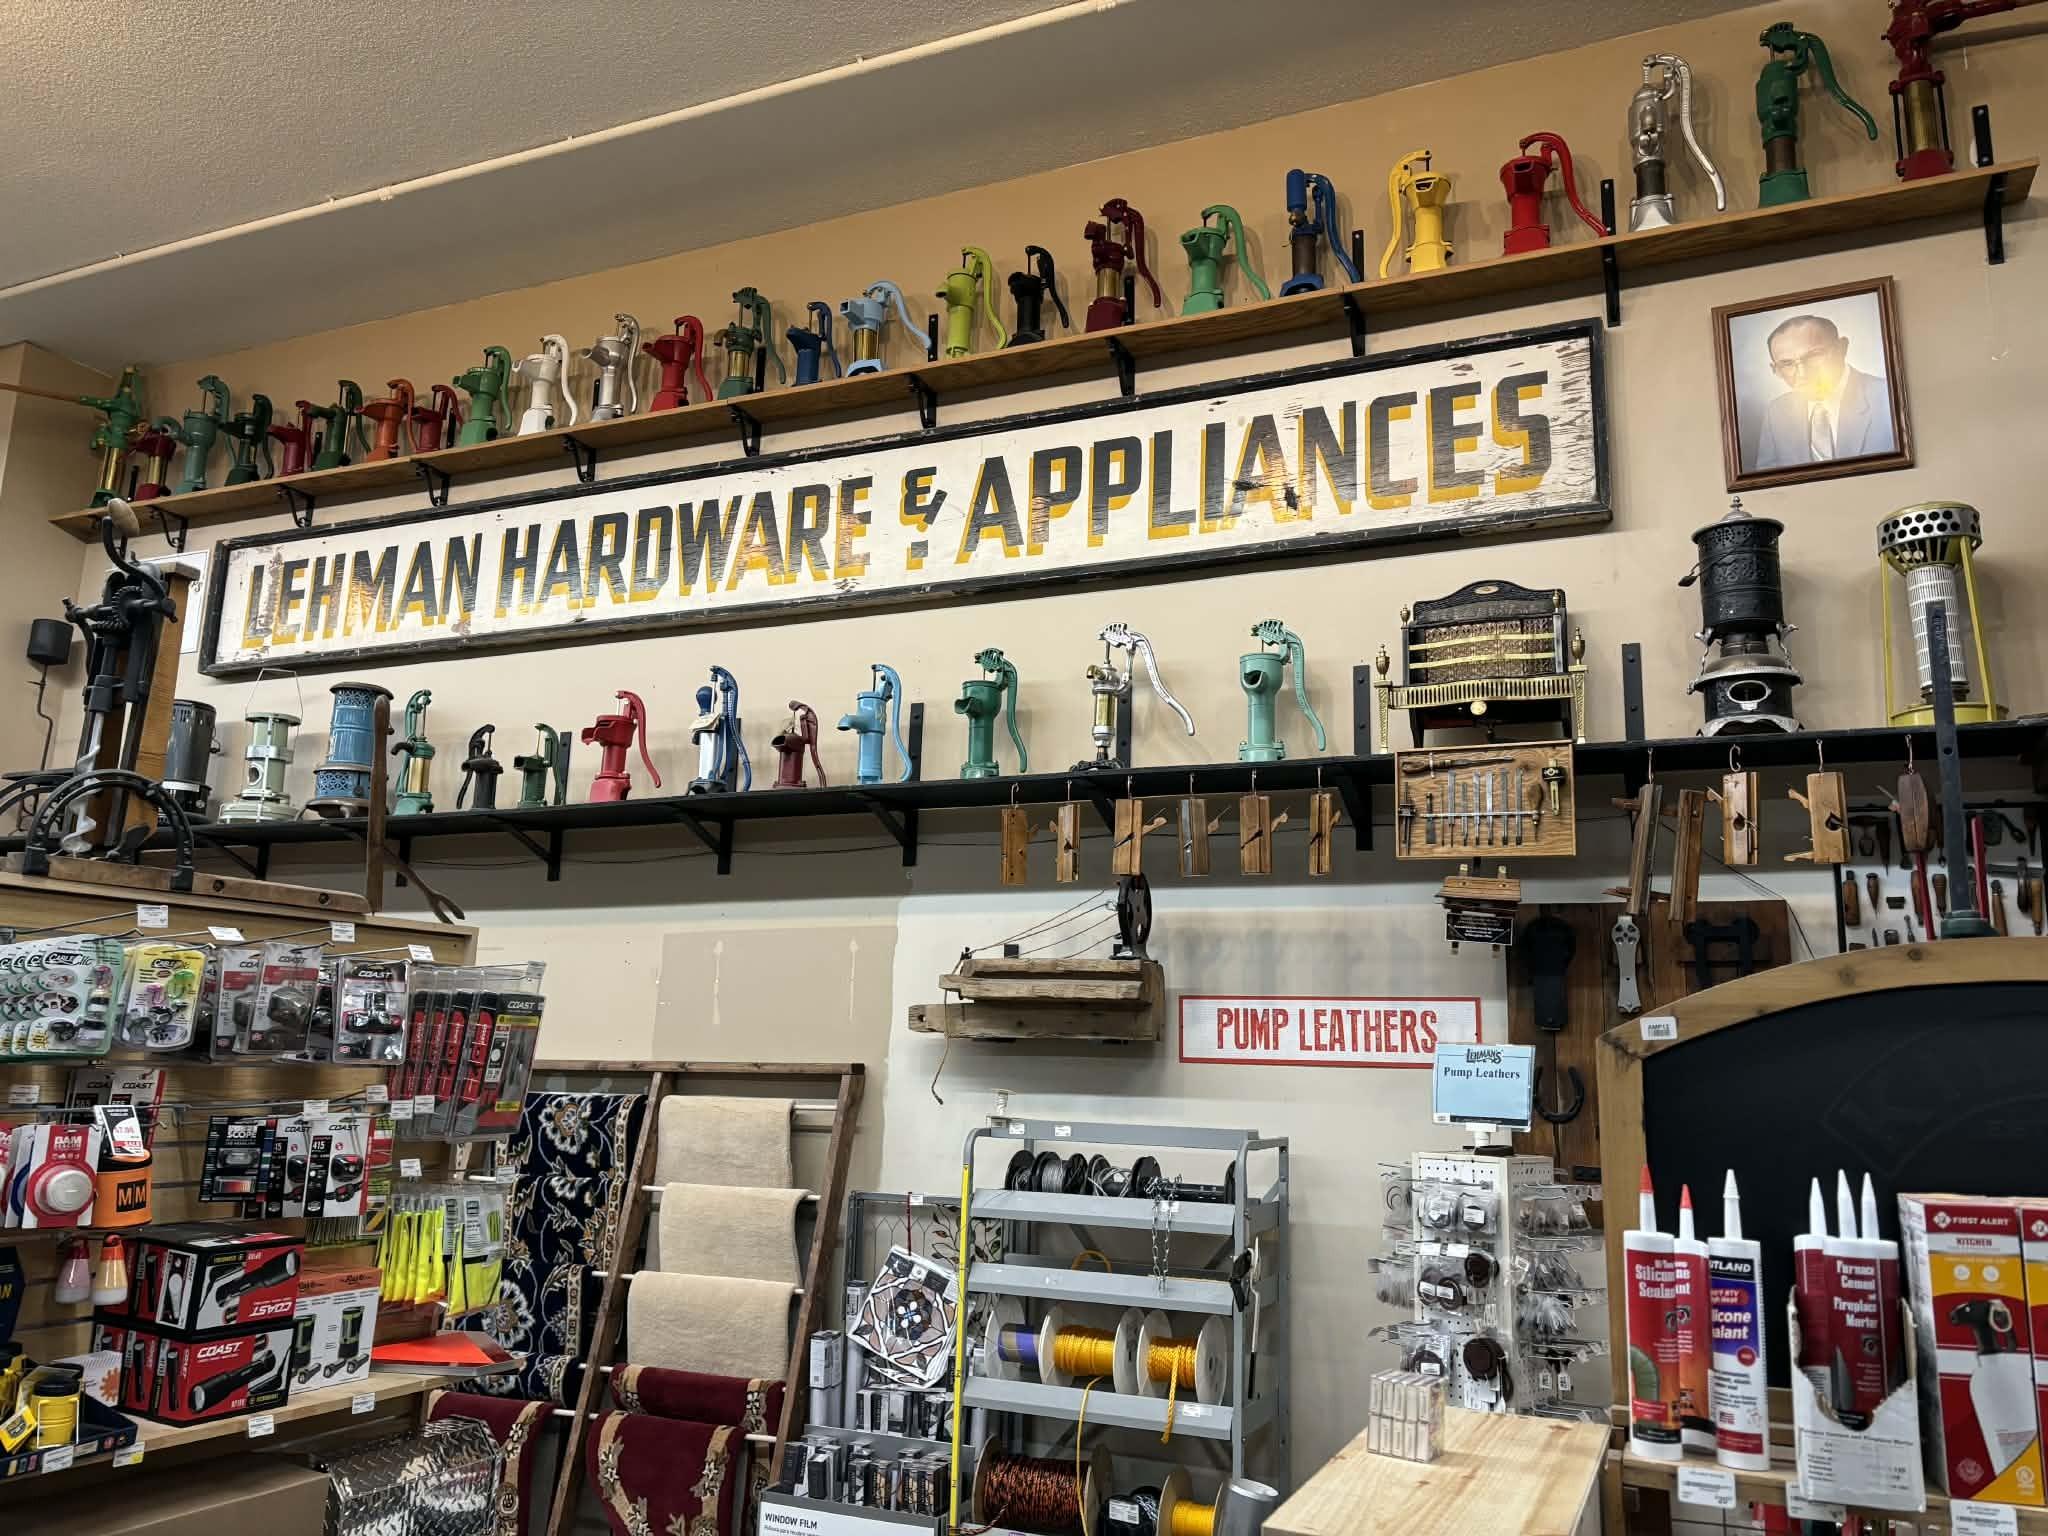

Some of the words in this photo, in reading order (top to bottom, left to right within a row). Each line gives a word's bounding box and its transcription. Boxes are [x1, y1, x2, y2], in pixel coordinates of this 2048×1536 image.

[242, 532, 484, 650] LEHMAN
[495, 475, 875, 619] HARDWARE
[900, 464, 949, 570] &
[954, 370, 1551, 566] APPLIANCES
[239, 960, 260, 969] COA
[278, 955, 307, 964] COAST
[358, 970, 393, 979] COAST
[507, 1000, 535, 1010] COAST
[1216, 1007, 1289, 1051] PUMP
[1298, 1008, 1438, 1054] LEATHERS
[1443, 1067, 1473, 1079] Pump
[1475, 1068, 1521, 1080] Leathers
[87, 1081, 113, 1090] COA
[122, 1082, 154, 1090] COAST
[328, 1124, 361, 1132] COAST
[312, 1141, 325, 1151] 415
[1952, 1217, 1978, 1225] FIRST
[1979, 1218, 2009, 1226] ALERT
[1710, 1260, 1752, 1273] TLAND
[250, 1300, 293, 1317] COAST
[1711, 1308, 1752, 1323] licone
[1711, 1325, 1749, 1340] alant
[197, 1341, 244, 1358] COAST
[764, 1512, 798, 1526] WINDOW
[799, 1518, 817, 1529] FILM
